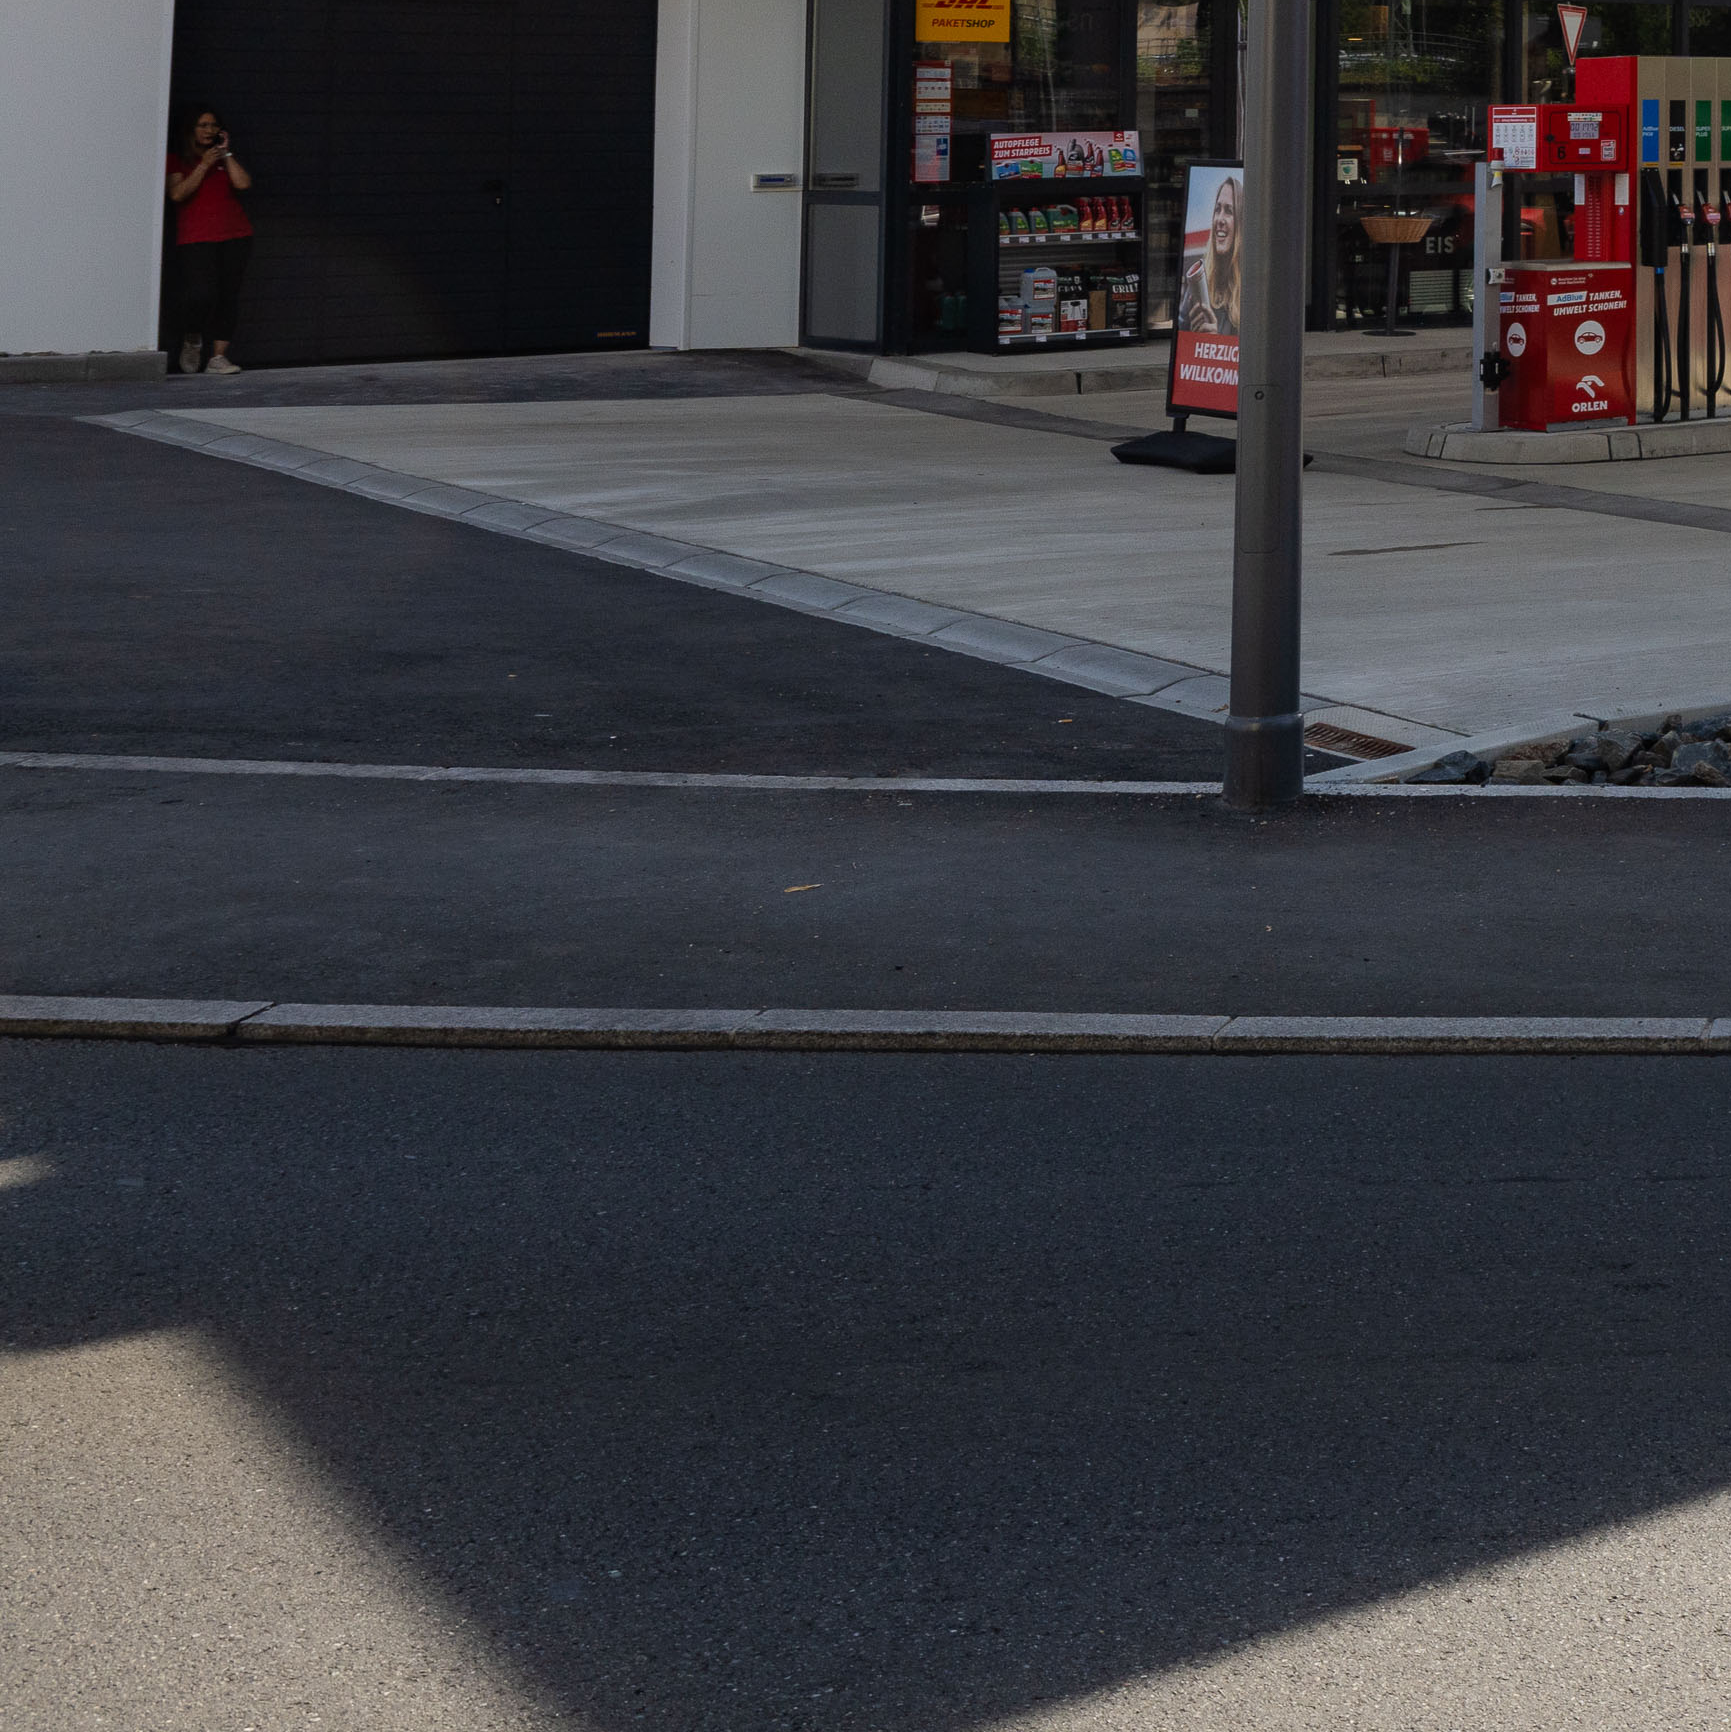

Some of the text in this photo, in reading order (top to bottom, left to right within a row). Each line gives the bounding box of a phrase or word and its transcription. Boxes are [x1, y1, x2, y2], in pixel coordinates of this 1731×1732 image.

[931, 18, 995, 28] PAKETSHOP
[994, 139, 1040, 149] AUTOPFLEGE
[994, 147, 1051, 158] ZUM STARPREIS
[1557, 146, 1566, 160] 6
[1425, 236, 1455, 254] EIS
[1556, 290, 1623, 303] AdBlue TANKEN,
[1554, 304, 1588, 316] UMWELT
[1571, 400, 1608, 413] ORLEN
